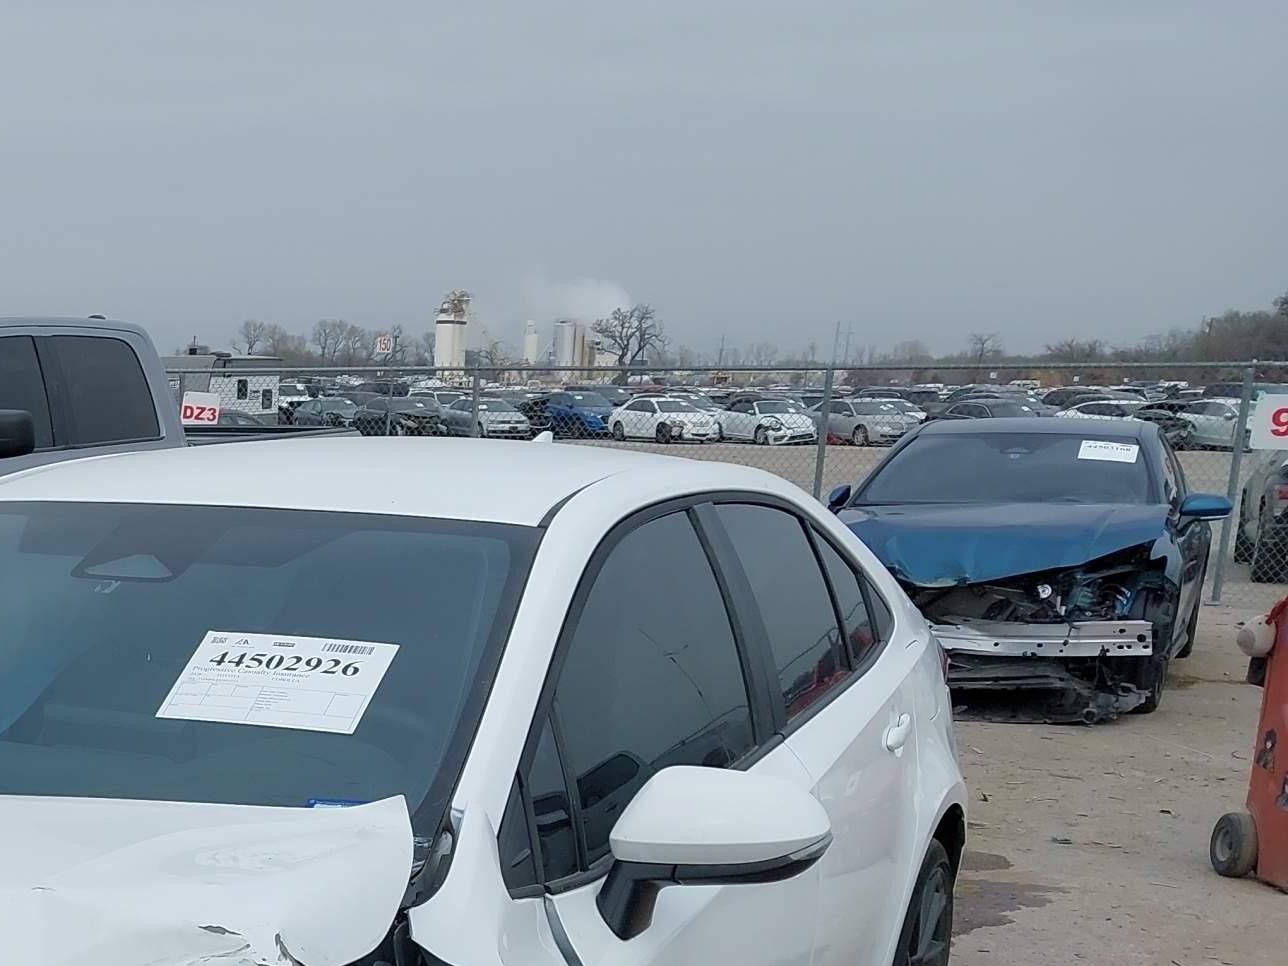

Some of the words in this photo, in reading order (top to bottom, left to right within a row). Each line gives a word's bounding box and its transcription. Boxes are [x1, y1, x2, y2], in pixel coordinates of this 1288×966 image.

[183, 405, 217, 421] DZ3
[191, 665, 236, 674] Progressive
[237, 668, 270, 677] Casualty
[272, 671, 311, 679] Insurance
[209, 651, 365, 677] 44502926
